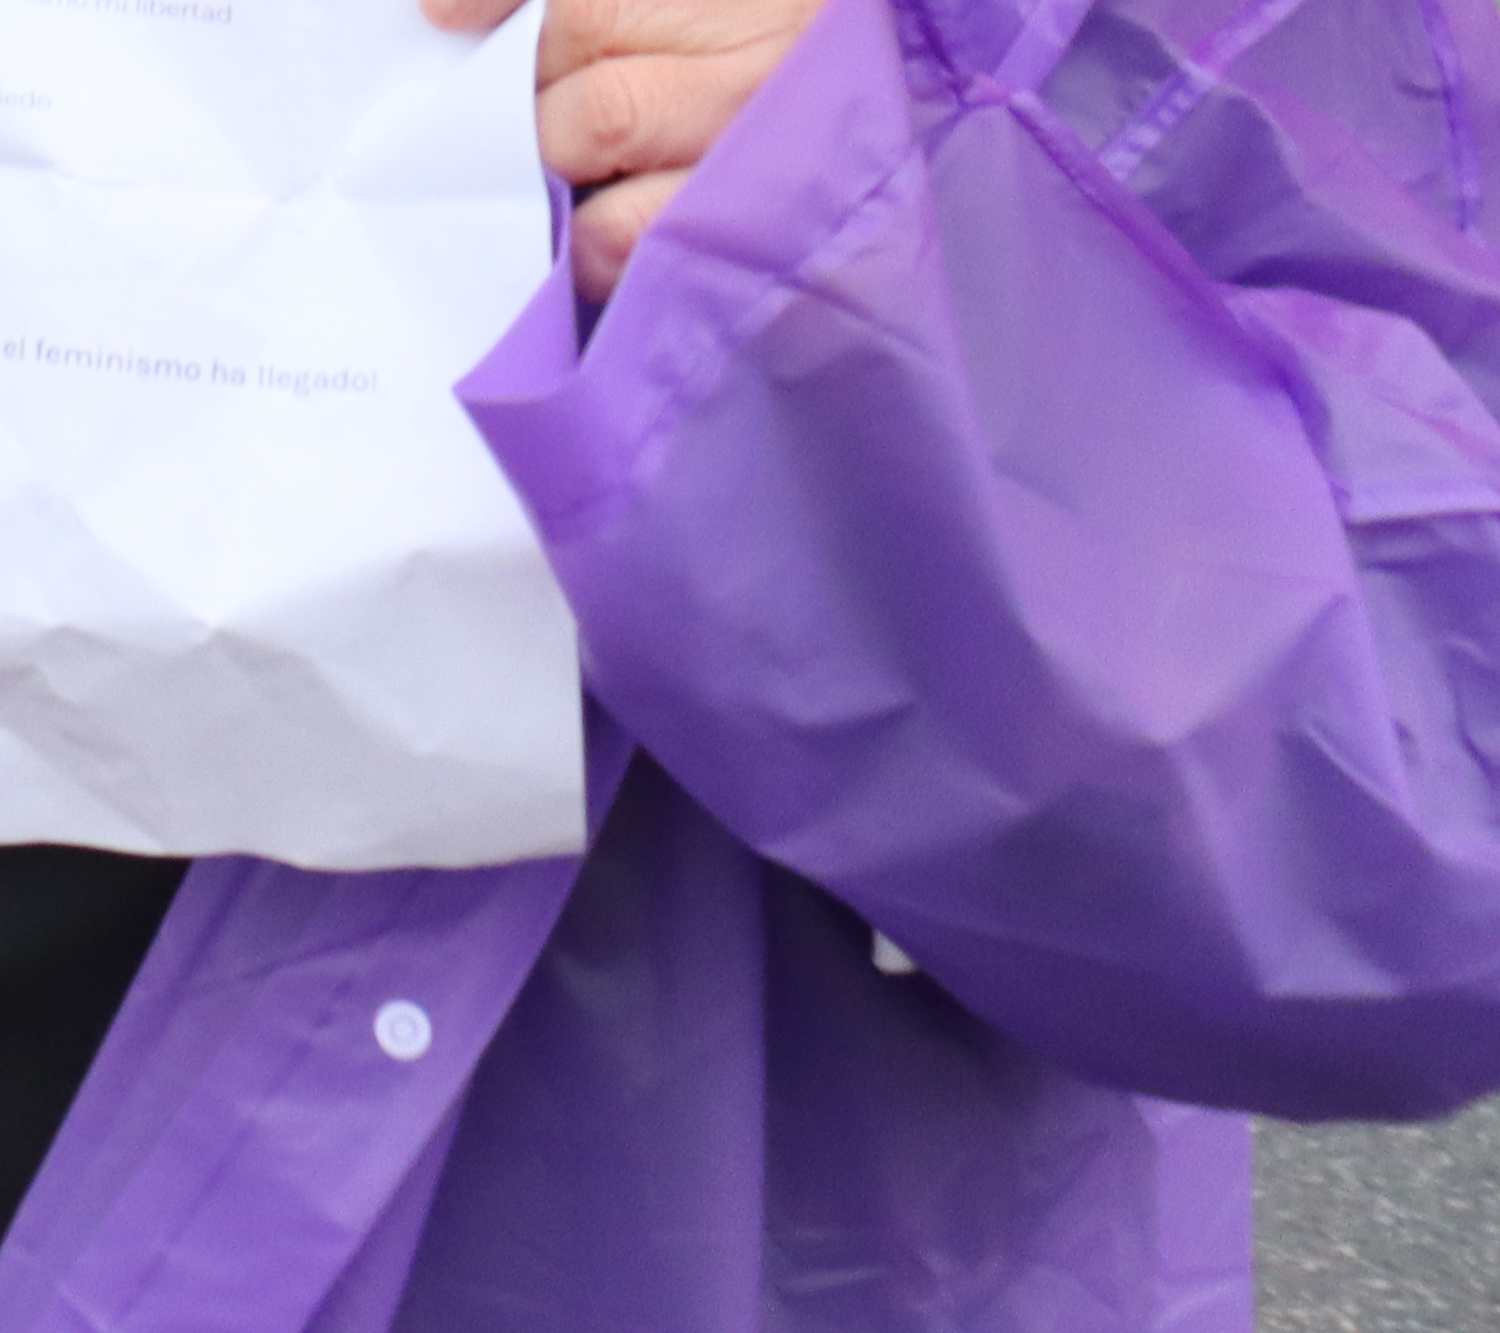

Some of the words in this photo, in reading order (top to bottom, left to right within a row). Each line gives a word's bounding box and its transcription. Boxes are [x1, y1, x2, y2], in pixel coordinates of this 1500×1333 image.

[2, 335, 26, 362] el
[34, 336, 202, 383] feminismo
[209, 357, 247, 386] ha
[257, 364, 378, 399] llegado!
